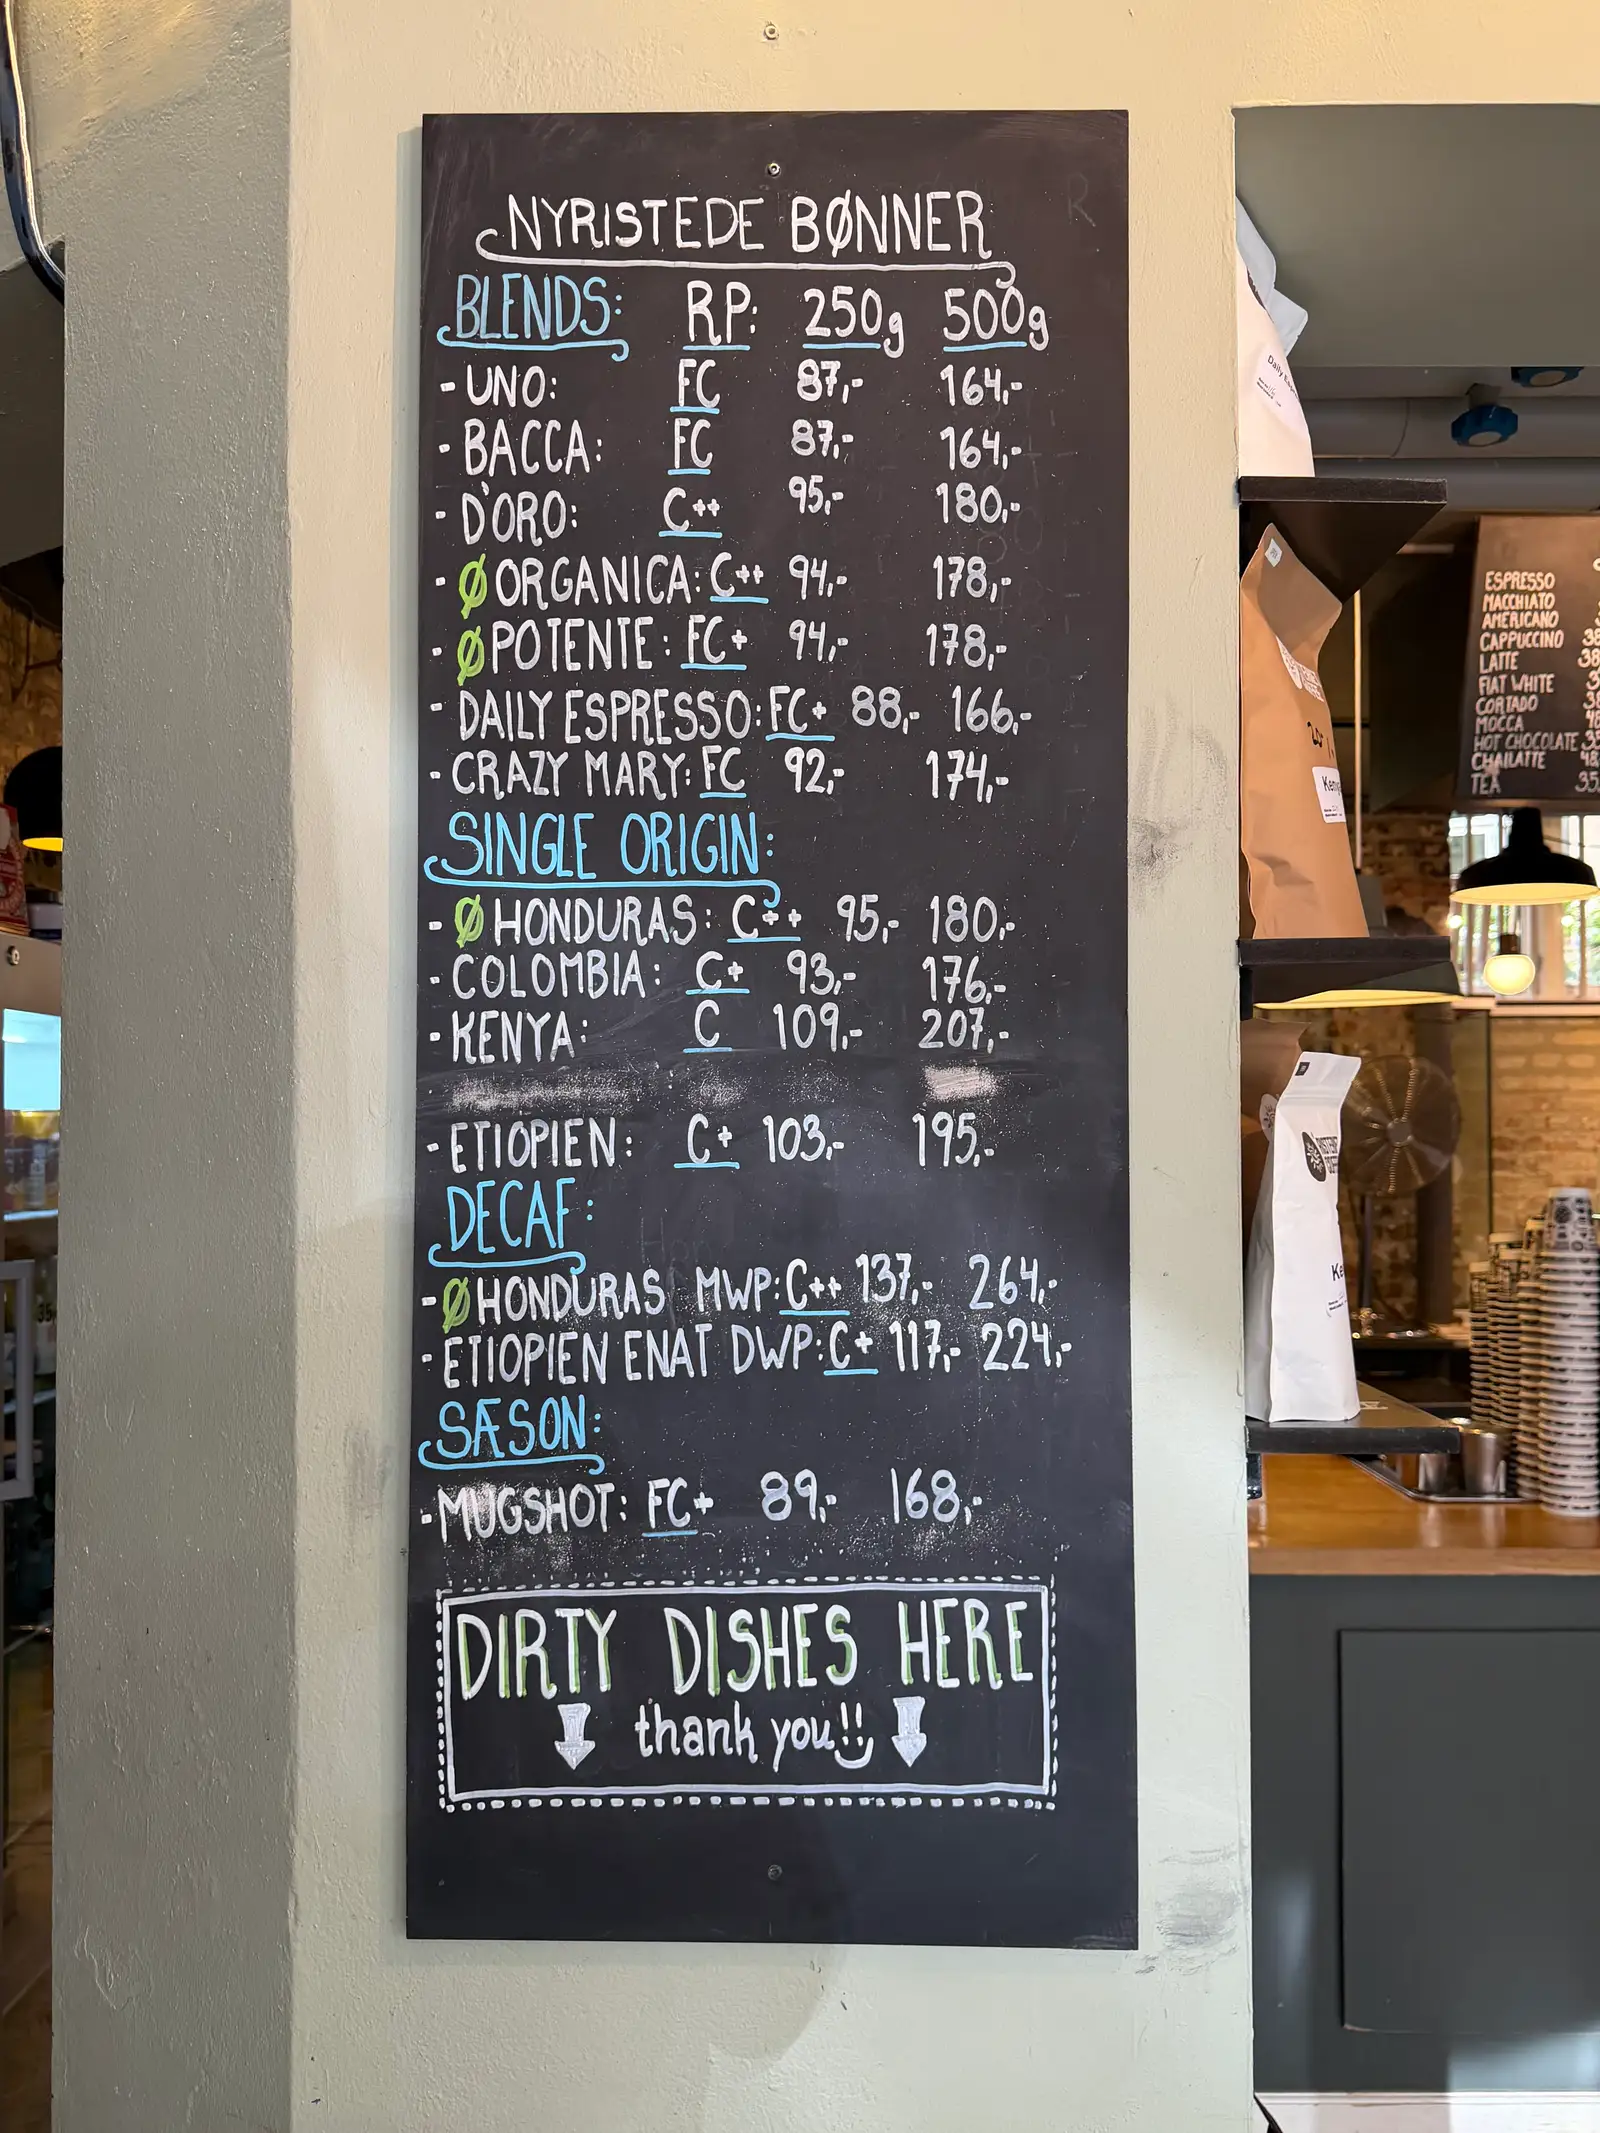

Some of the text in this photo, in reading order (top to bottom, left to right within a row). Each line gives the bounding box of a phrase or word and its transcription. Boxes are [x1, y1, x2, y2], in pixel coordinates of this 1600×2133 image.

[508, 193, 765, 252] NYRISTEDE
[790, 188, 993, 260] BØNNER
[456, 273, 1050, 358] BLENDS: RP: 250g 500g
[466, 358, 1023, 409] UNO: FC 87,- 164,-
[1267, 354, 1284, 377] Daily
[463, 417, 1023, 478] BACCA: FC 87,- 164,-
[664, 486, 720, 532] C++
[788, 474, 844, 516] 95,-
[935, 481, 1021, 524] 180,-
[709, 551, 764, 597] C++
[788, 554, 848, 598] 94,-
[932, 554, 1012, 604] 178,-
[1482, 592, 1556, 613] MACCHIATO
[1485, 570, 1556, 592] ESPRESSO
[688, 614, 748, 663] FC+
[788, 619, 849, 663] 94,-
[925, 623, 1008, 672] 178,-
[1480, 629, 1564, 652] CAPPUCCINO
[1481, 610, 1560, 630] AMERICANO
[1480, 651, 1520, 674] LATTE
[1511, 673, 1555, 694] WHITE
[459, 688, 553, 742] DAILY
[768, 685, 827, 734] FC+
[851, 684, 921, 735] 88,-
[951, 684, 1033, 736] 166,-
[1475, 714, 1524, 734] MOCCA
[1476, 694, 1538, 716] CORTADO
[1473, 733, 1502, 752] HOT
[1505, 731, 1579, 752] CHOCOLATE
[451, 744, 1010, 804] CRAZY MARY: FC 92,- 174,-
[1471, 772, 1502, 796] TEA
[445, 812, 773, 882] SINGLE ORIGIN:
[494, 893, 712, 947] HONDURAS:
[731, 893, 802, 938] C++
[836, 897, 900, 945] 95,-
[929, 894, 1016, 942] 180,-
[452, 949, 1007, 1005] COLOMBIA: C+ 93,- 176,-
[451, 999, 1010, 1065] KENYA: C 109,- 207,-
[450, 1111, 995, 1174] ETIOPIEN: C+ 103,- 195,-
[446, 1177, 593, 1254] DECAF:
[476, 1268, 667, 1326] HONDURAS
[785, 1258, 842, 1311] C++
[854, 1252, 934, 1305] 137,-
[968, 1253, 1058, 1312] 264,-
[443, 1330, 609, 1389] ETIOPIEN
[624, 1322, 713, 1382] ENAT
[829, 1323, 874, 1371] C+
[888, 1319, 962, 1374] 117,-
[982, 1318, 1073, 1372] 224,-
[436, 1396, 601, 1458] SÆSON:
[437, 1467, 983, 1544] MUGSHOT: FC+ 89,- 168,-
[456, 1597, 1034, 1701] DIRTY DISHES HERE
[634, 1700, 759, 1764] thank
